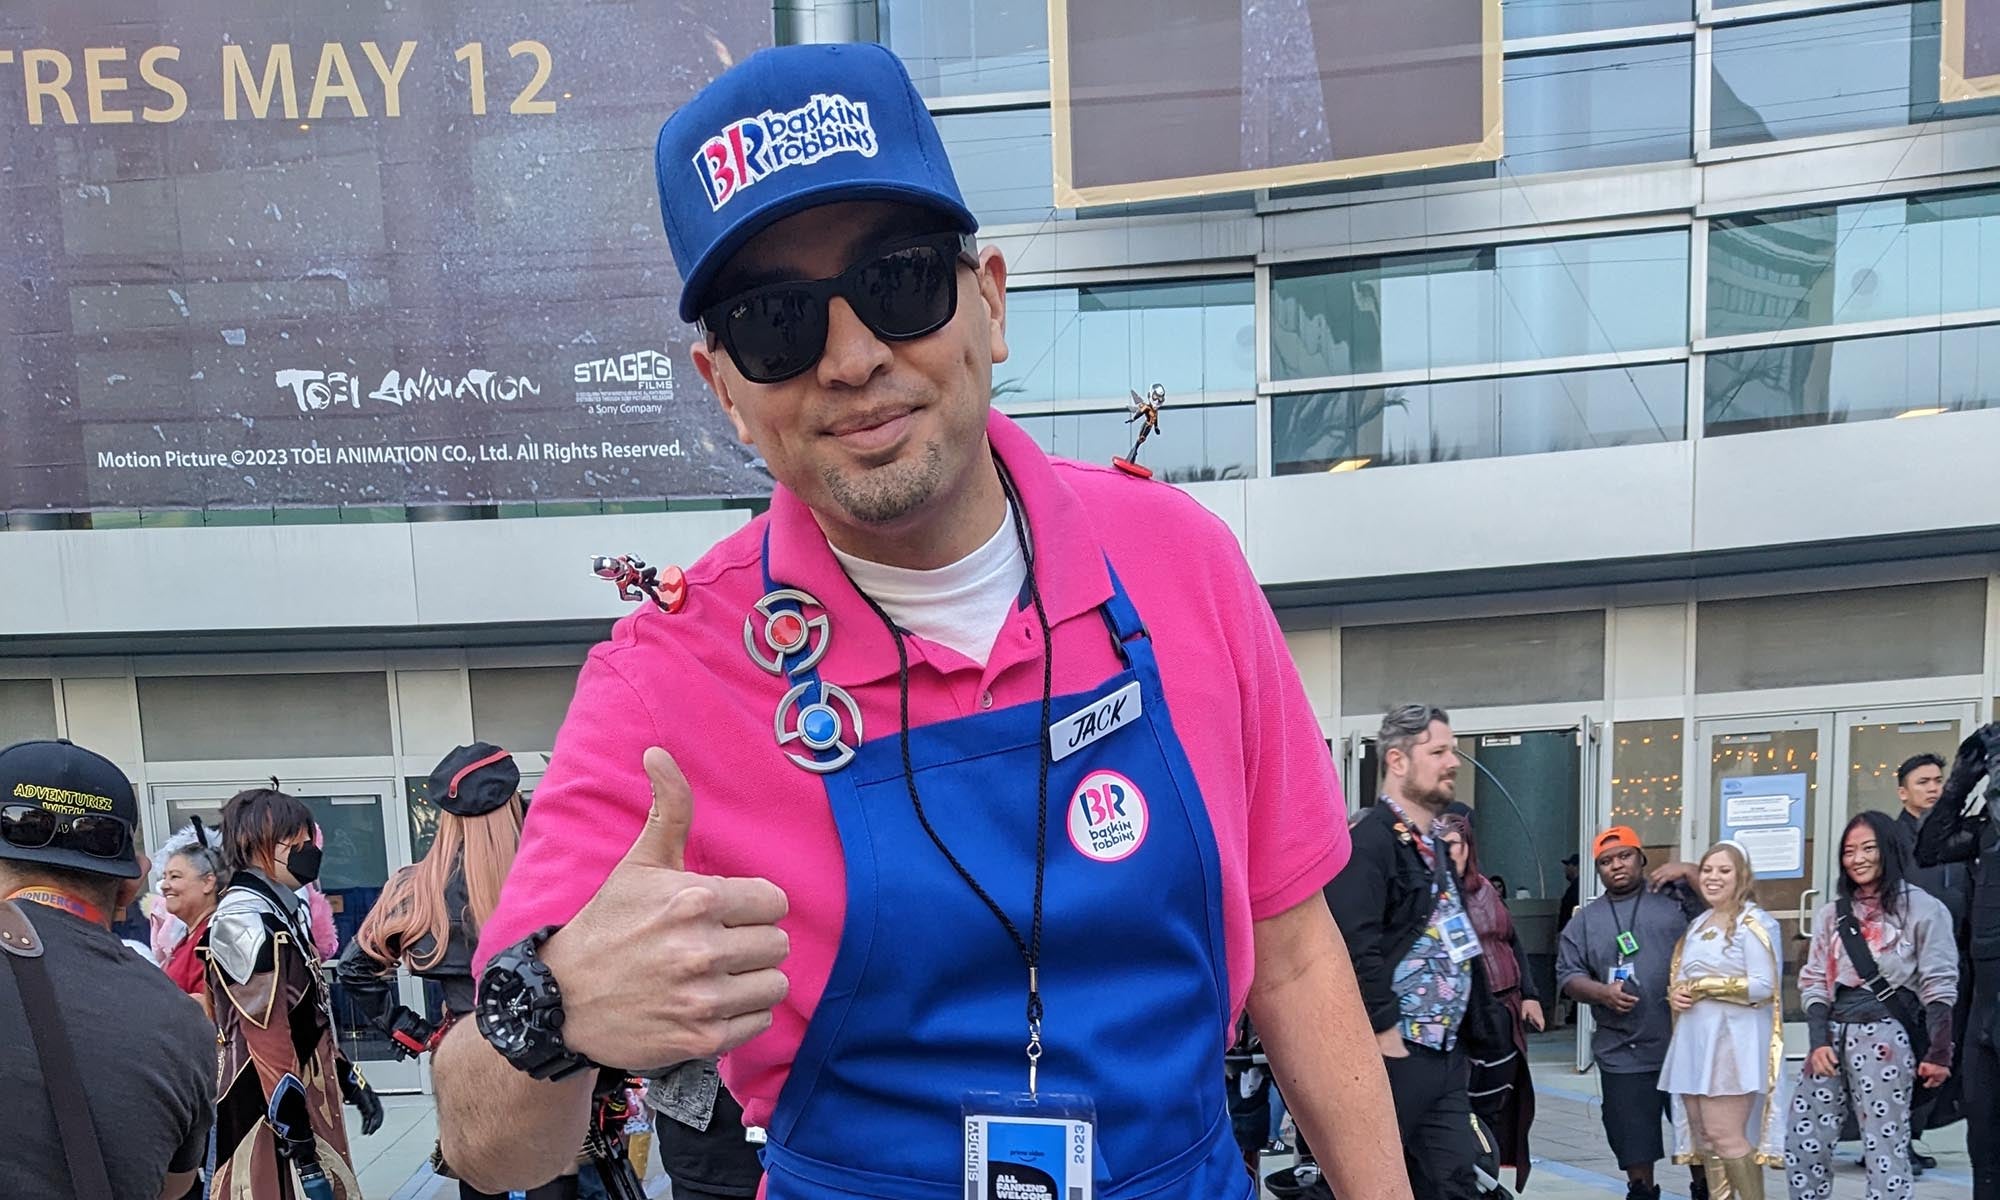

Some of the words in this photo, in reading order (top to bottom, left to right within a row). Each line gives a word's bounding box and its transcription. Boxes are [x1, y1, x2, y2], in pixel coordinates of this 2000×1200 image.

[0, 45, 188, 125] RES
[222, 41, 418, 120] MAY
[454, 40, 557, 115] 12
[763, 99, 865, 142] baskin
[771, 126, 873, 167] robbins
[695, 121, 774, 207] BR
[276, 368, 361, 412] TOEI
[368, 366, 541, 407] ANIMATION
[638, 380, 673, 390] FILMS
[588, 405, 594, 414] a
[596, 404, 619, 415] Sony
[620, 403, 662, 414] Company
[98, 451, 162, 468] Motion
[165, 450, 228, 467] Picture
[231, 449, 289, 465] ©2023
[290, 447, 332, 465] TOEI
[336, 445, 438, 464] ANIMATION
[442, 444, 477, 464] CO.,
[480, 444, 513, 462] Ltd.
[517, 442, 539, 461] All
[544, 442, 598, 463] Rights
[602, 440, 685, 459] Reserved.
[1068, 694, 1128, 748] JACK
[14, 783, 113, 811] ADVENTUREZ
[1079, 783, 1126, 827] BR
[1088, 820, 1133, 841] baskin
[1092, 831, 1136, 852] robbins
[967, 1121, 979, 1182] SUNDAY
[1073, 1125, 1085, 1164] 2023
[995, 1182, 1048, 1193] FANKIND
[996, 1174, 1018, 1183] ALL
[996, 1191, 1053, 1200] WELCOME
